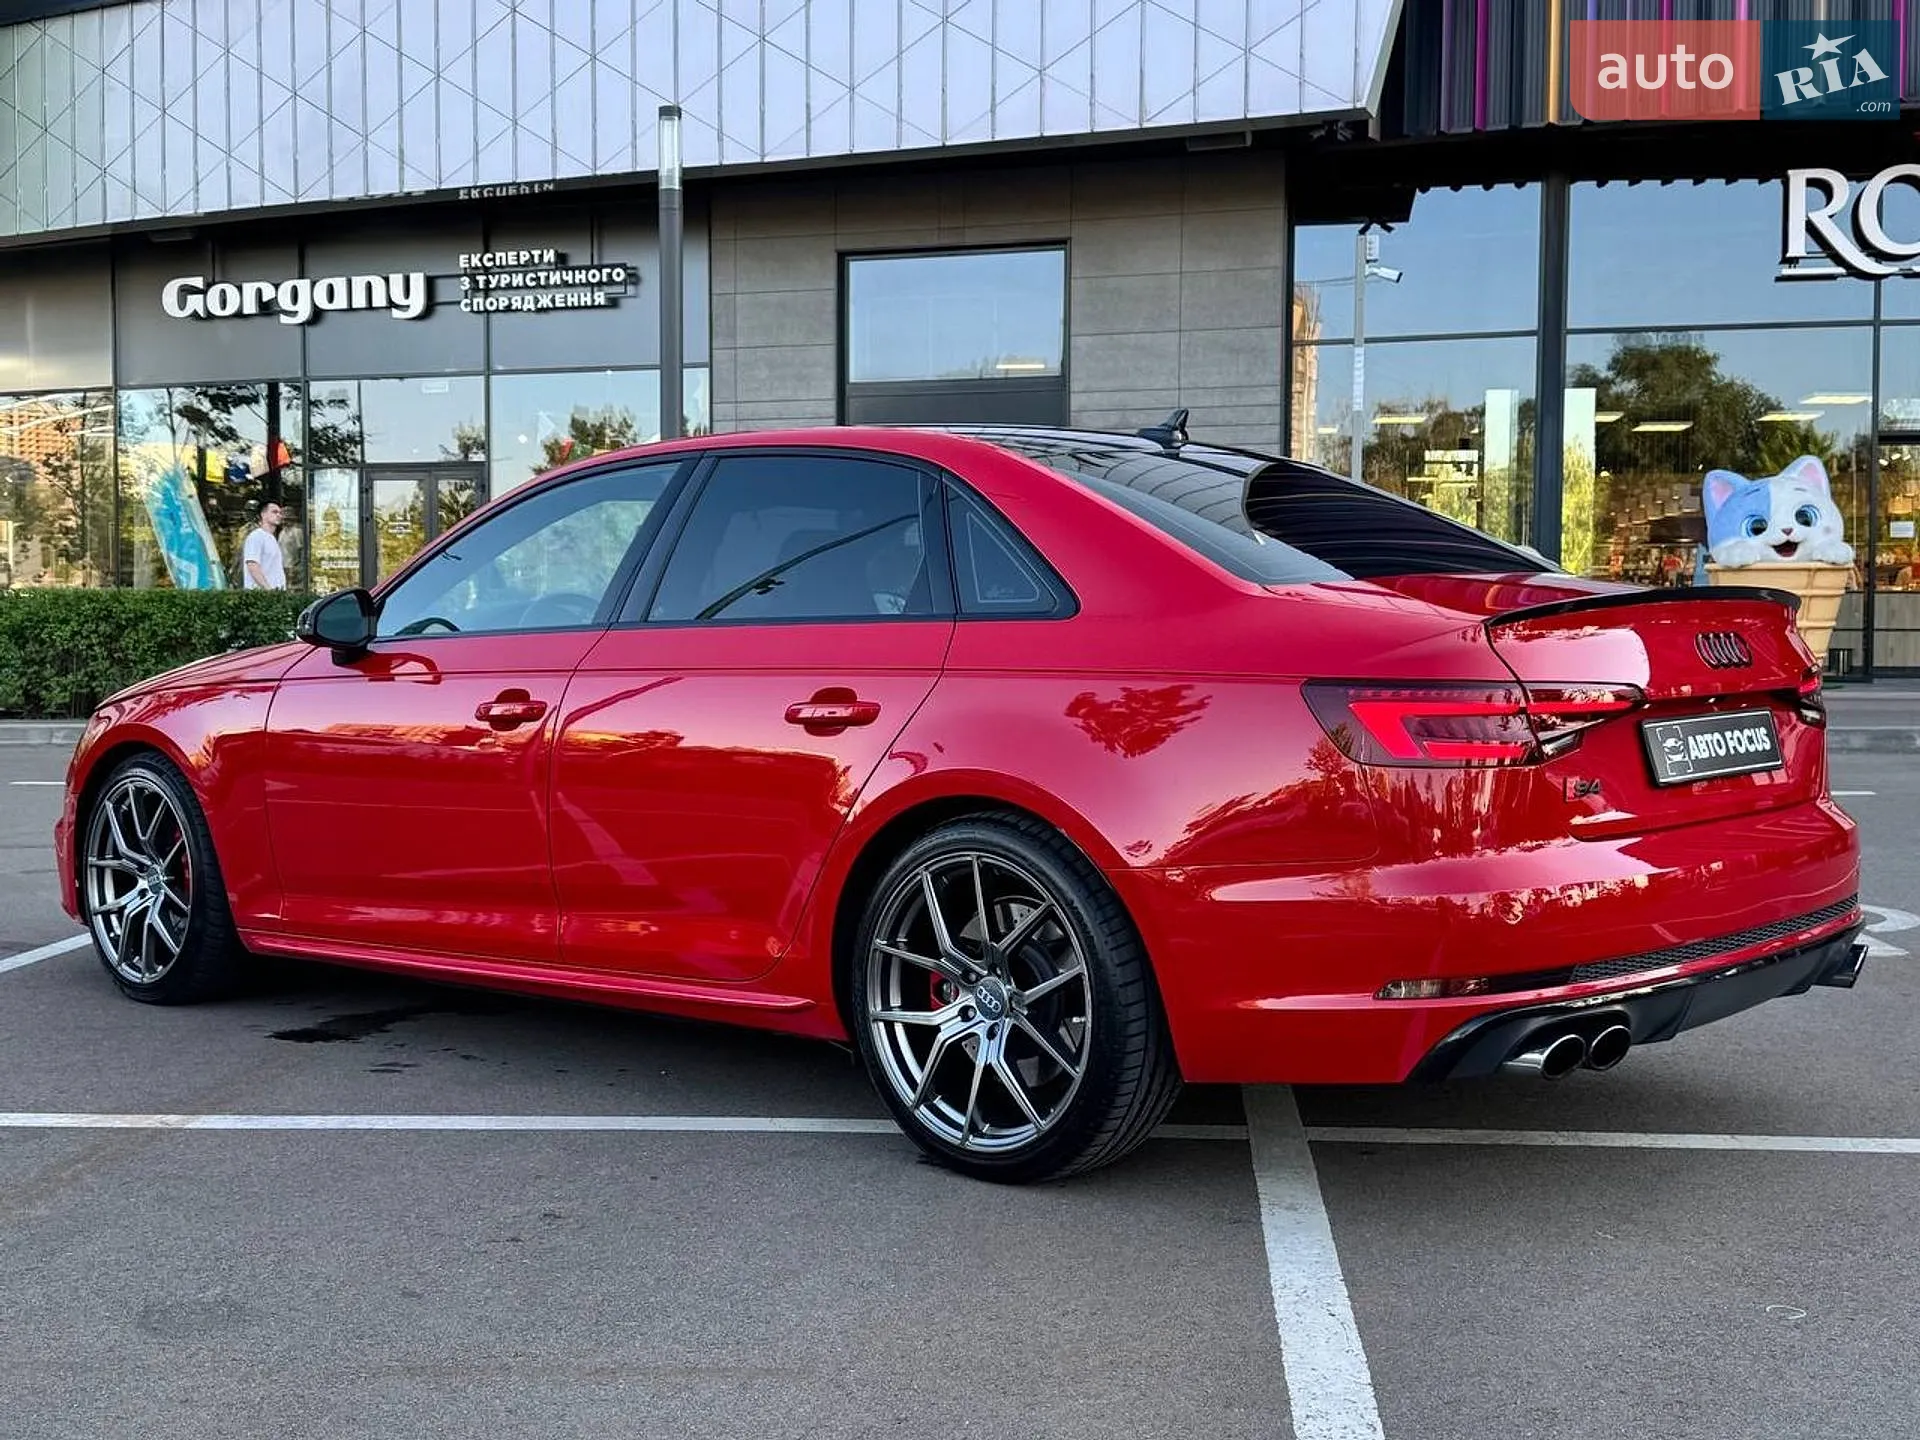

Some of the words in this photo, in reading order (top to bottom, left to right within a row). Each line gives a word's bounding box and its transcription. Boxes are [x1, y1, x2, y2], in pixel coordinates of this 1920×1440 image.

[458, 249, 556, 269] ЕКСПЕРТИ
[476, 267, 626, 290] ТУРИСТИЧНОГО
[161, 271, 427, 325] Gorgany
[460, 292, 606, 312] СПОРЯДЖЕННЯ
[1725, 726, 1771, 754] FOCUS
